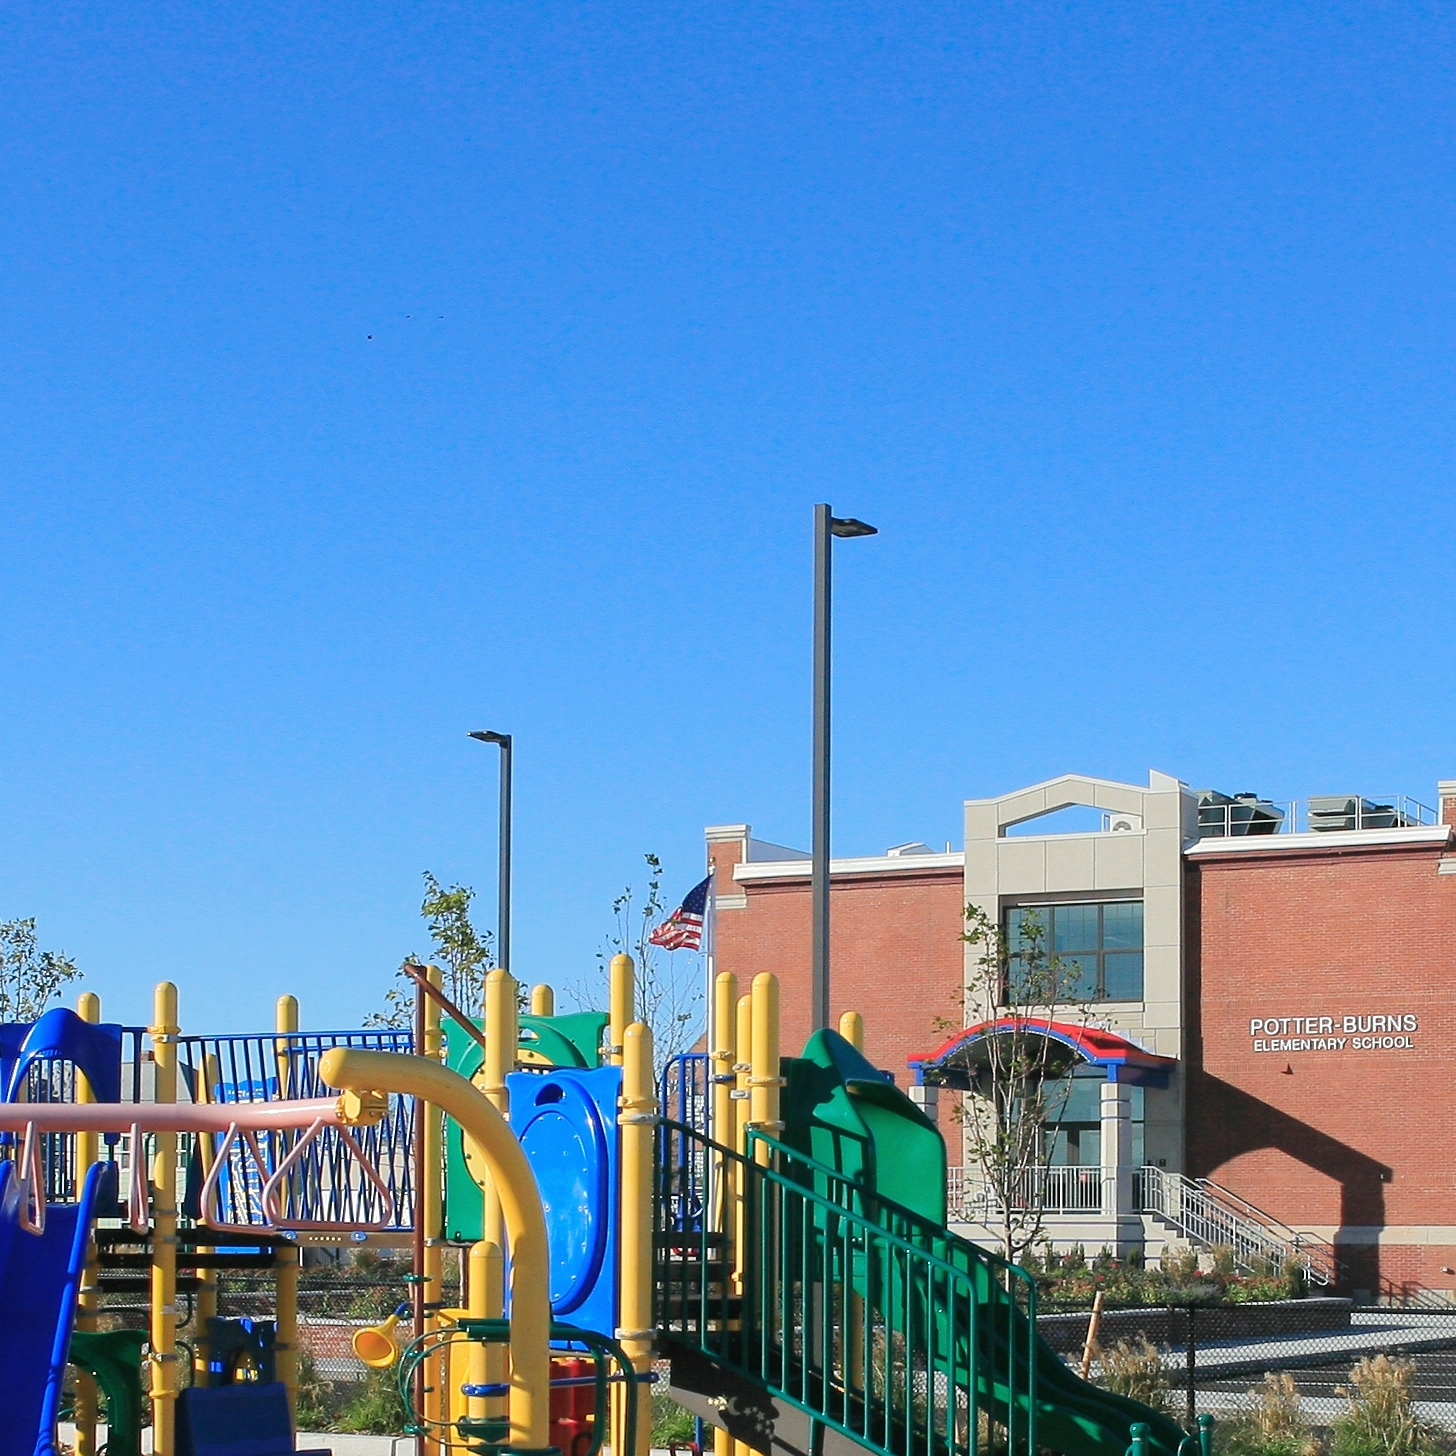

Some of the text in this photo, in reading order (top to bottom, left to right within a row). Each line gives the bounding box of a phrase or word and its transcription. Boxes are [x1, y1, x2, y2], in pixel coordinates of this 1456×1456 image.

[1250, 1014, 1417, 1036] POTTER-BURNS
[1253, 1035, 1414, 1052] ELEMENTARY SCHOOL
